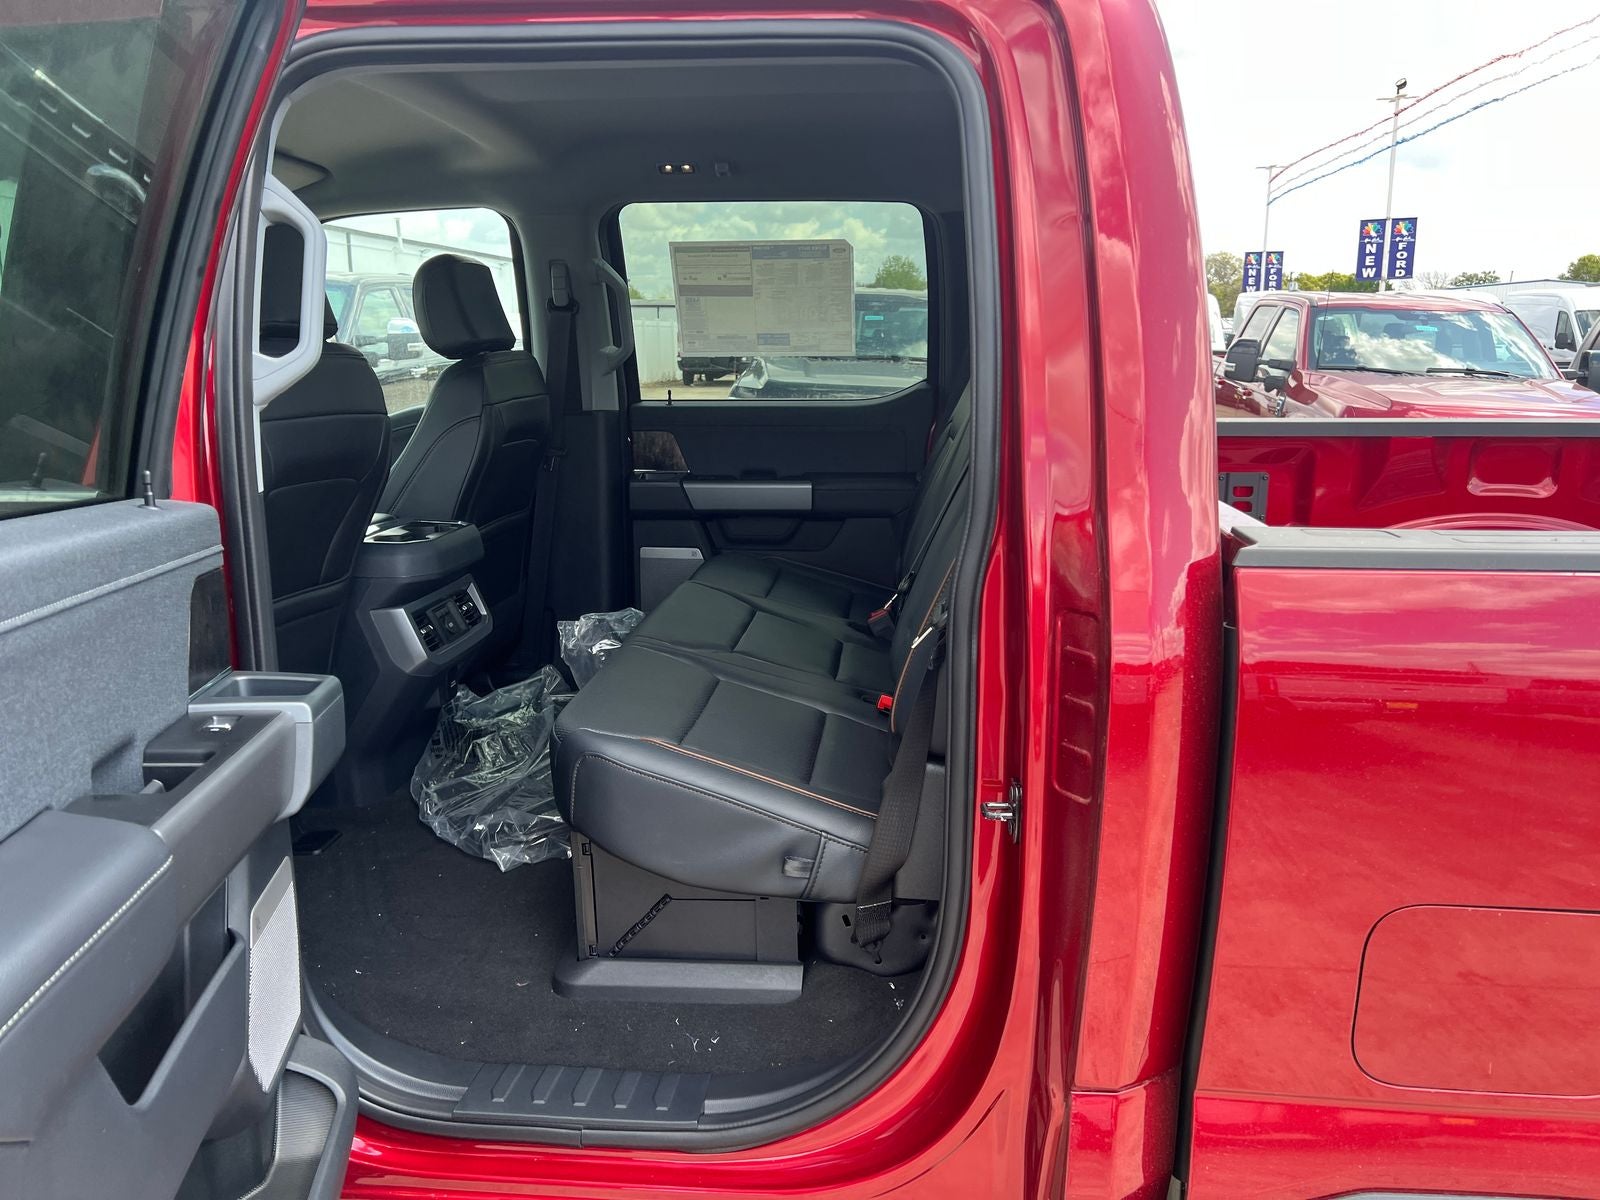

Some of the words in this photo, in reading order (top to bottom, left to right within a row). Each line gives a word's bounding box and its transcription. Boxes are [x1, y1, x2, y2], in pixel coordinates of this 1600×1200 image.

[1361, 243, 1376, 278] NEW
[1394, 242, 1408, 277] FORD
[1246, 268, 1257, 292] NEW
